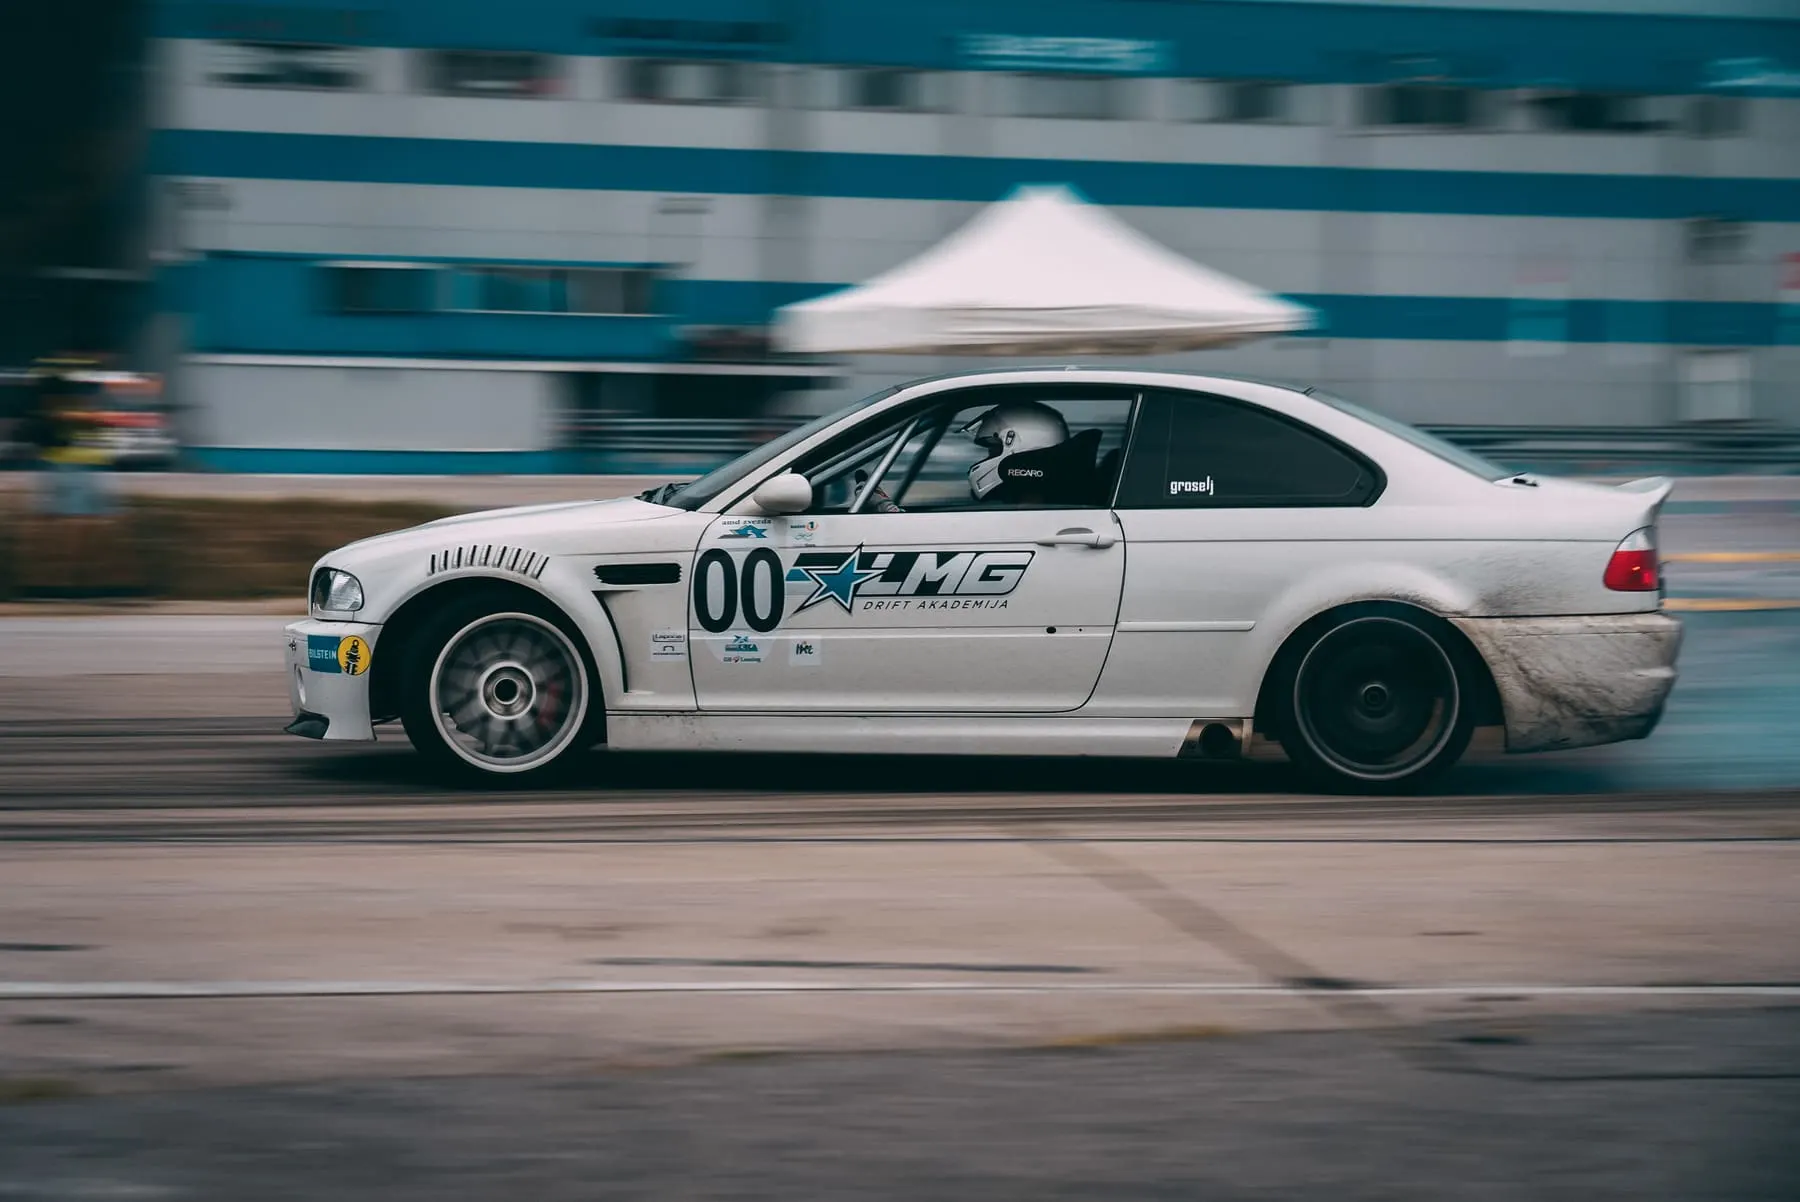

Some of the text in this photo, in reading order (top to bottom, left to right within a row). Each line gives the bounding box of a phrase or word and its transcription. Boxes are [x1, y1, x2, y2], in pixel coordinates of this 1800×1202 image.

[1007, 468, 1044, 478] RECARO
[1170, 475, 1214, 496] groselj
[857, 551, 1034, 595] LMG
[693, 547, 786, 633] 00
[863, 599, 1010, 611] DRIFT AKADEMIJA
[308, 648, 337, 660] BILSTEIN
